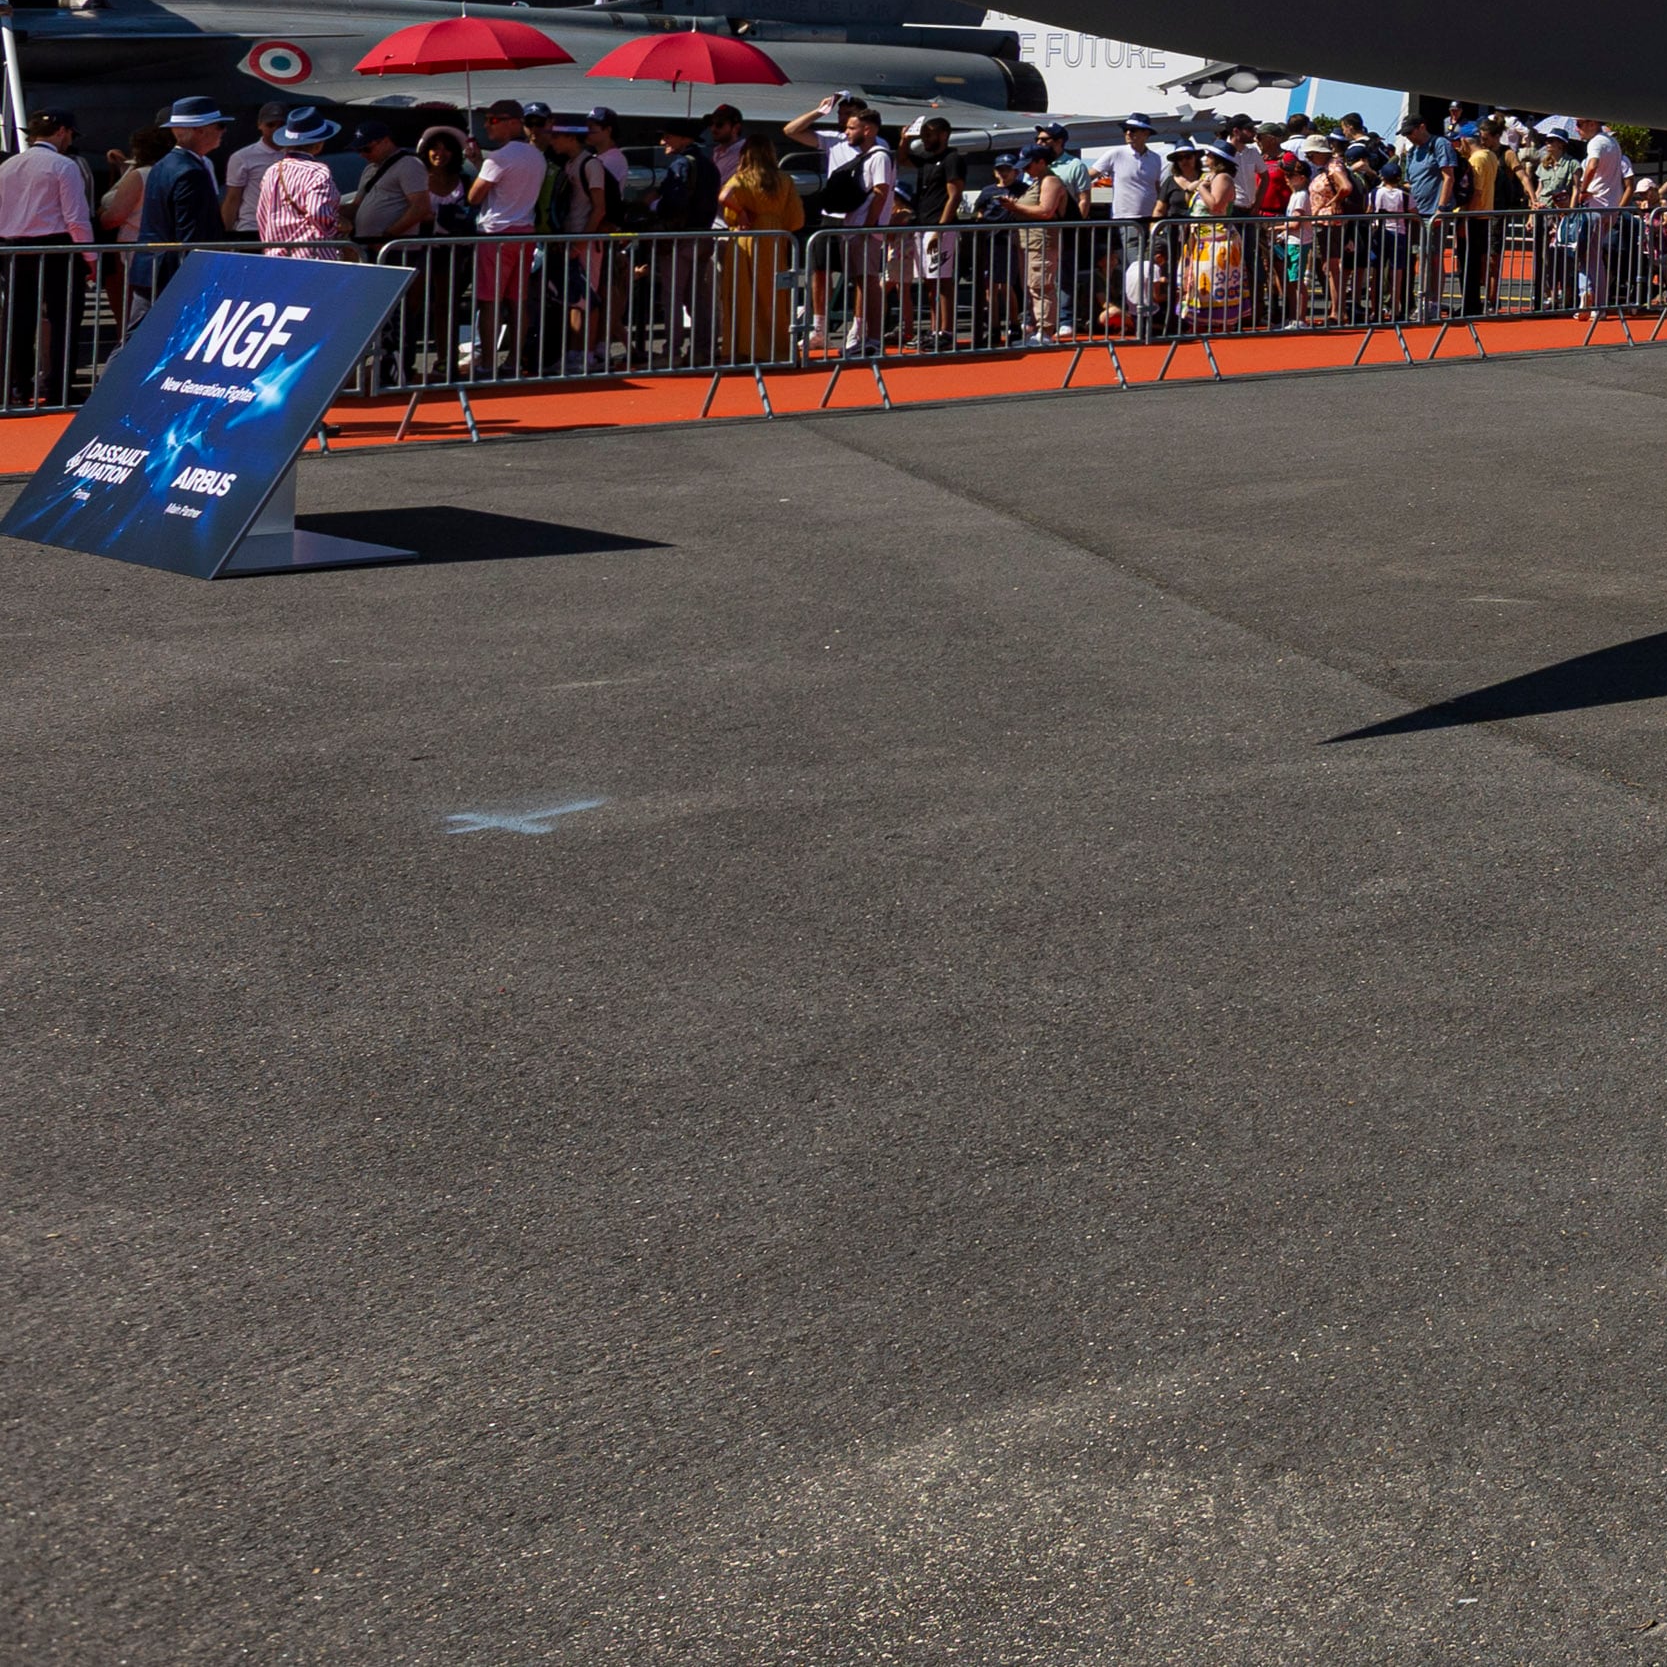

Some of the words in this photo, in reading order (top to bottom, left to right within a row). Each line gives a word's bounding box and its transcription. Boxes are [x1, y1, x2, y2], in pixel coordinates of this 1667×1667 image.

[1045, 33, 1166, 69] FUTURE
[184, 299, 311, 369] NGF
[160, 376, 182, 391] New
[180, 379, 226, 399] Generation
[222, 384, 257, 404] Fighter
[86, 442, 150, 467] DASSAULT
[73, 461, 133, 484] AVIATION
[171, 466, 237, 497] AIRBUS
[165, 502, 182, 515] Main
[179, 505, 203, 518] Partner
